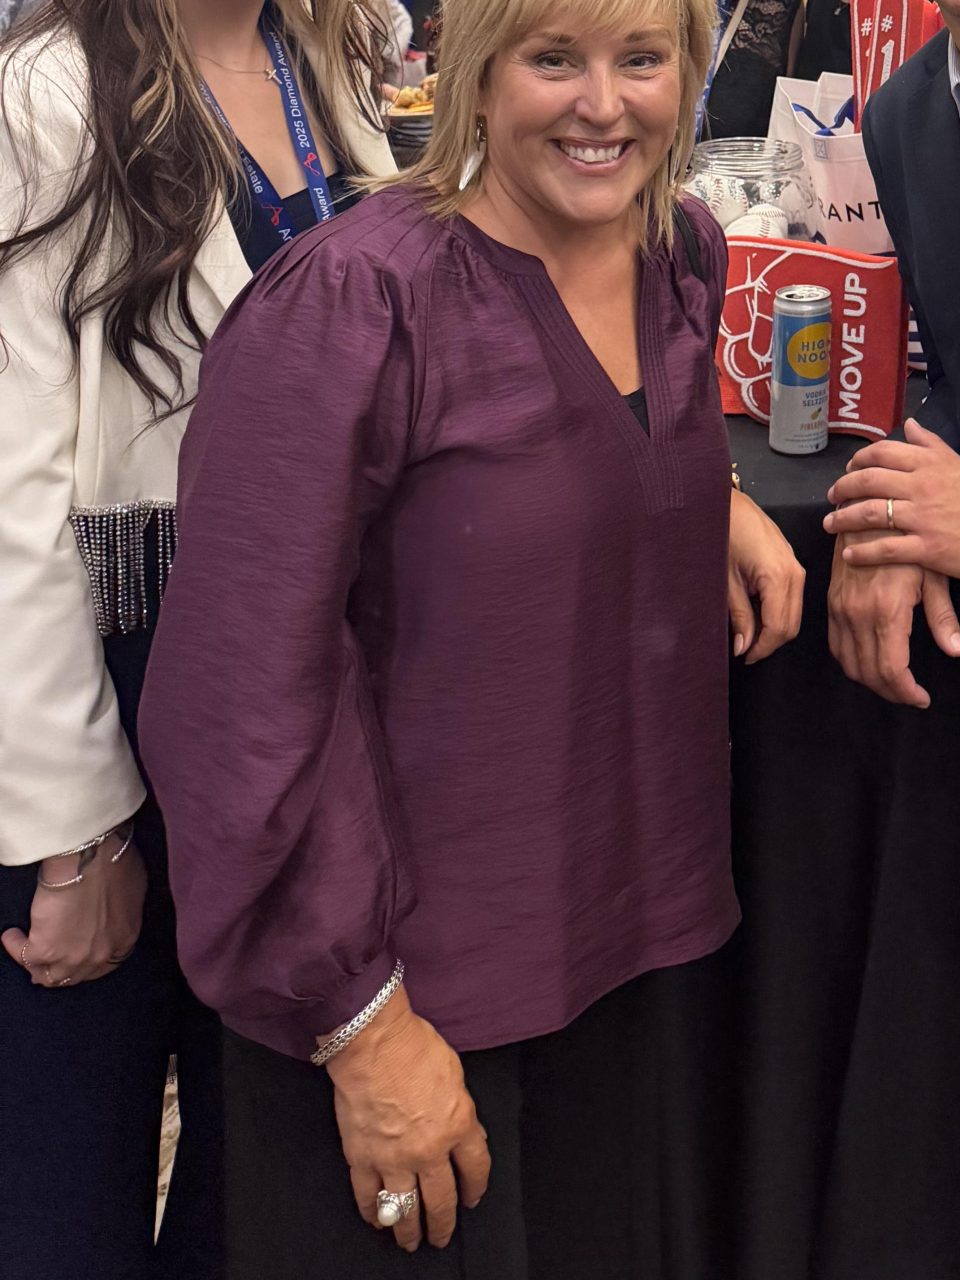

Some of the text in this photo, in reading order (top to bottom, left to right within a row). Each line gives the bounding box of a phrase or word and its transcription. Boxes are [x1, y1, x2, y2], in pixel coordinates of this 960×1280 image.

[279, 67, 302, 118] Diamond
[293, 119, 310, 149] 2025
[801, 338, 829, 352] HIG
[838, 272, 868, 420] MOVE UP
